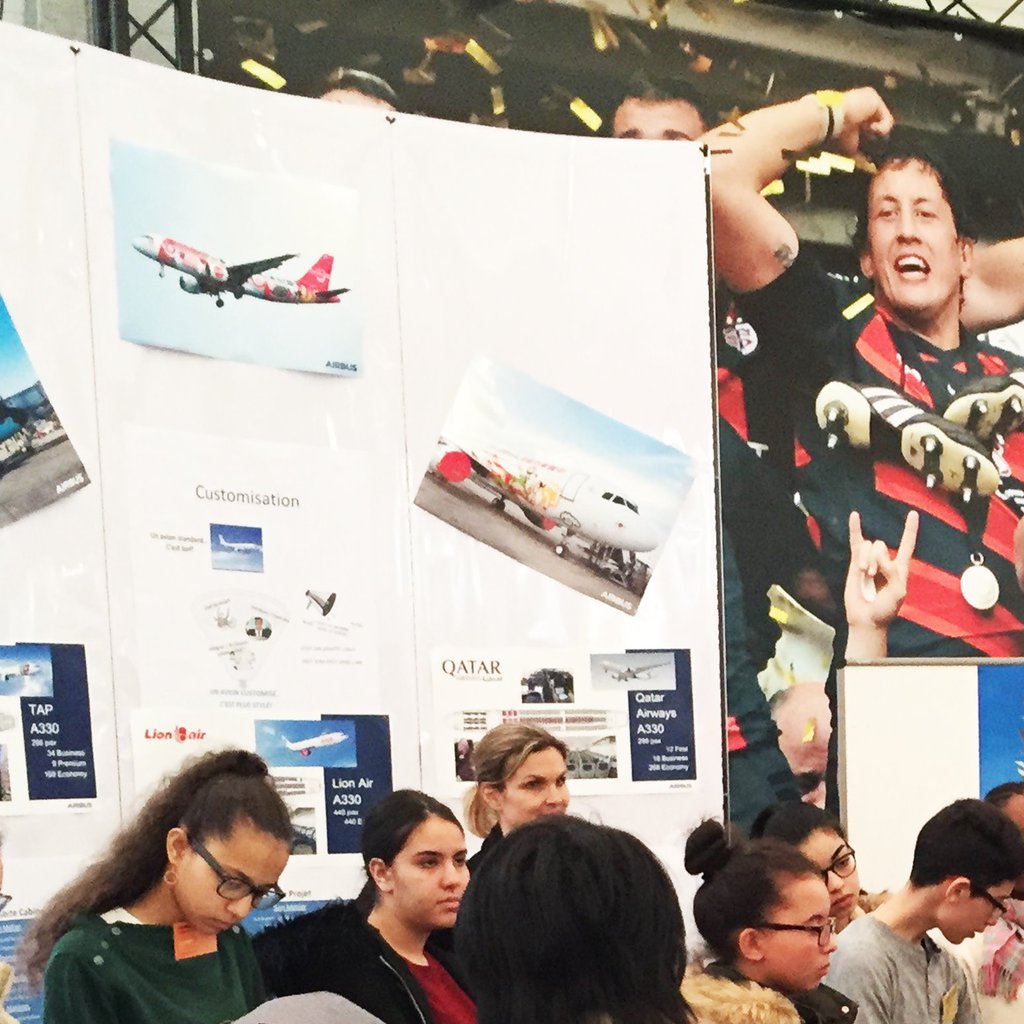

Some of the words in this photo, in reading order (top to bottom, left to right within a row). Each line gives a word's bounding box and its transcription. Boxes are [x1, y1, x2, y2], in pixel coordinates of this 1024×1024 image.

[195, 484, 300, 508] Customisation
[442, 659, 501, 676] QATAR
[635, 692, 665, 703] Qatar
[28, 703, 53, 716] TAP
[636, 708, 677, 720] Airways
[30, 722, 60, 734] A330
[637, 723, 665, 734] A330
[144, 729, 172, 740] Lion
[189, 729, 206, 740] air
[332, 778, 355, 789] Lion
[358, 778, 374, 789] Air
[332, 794, 362, 806] A330
